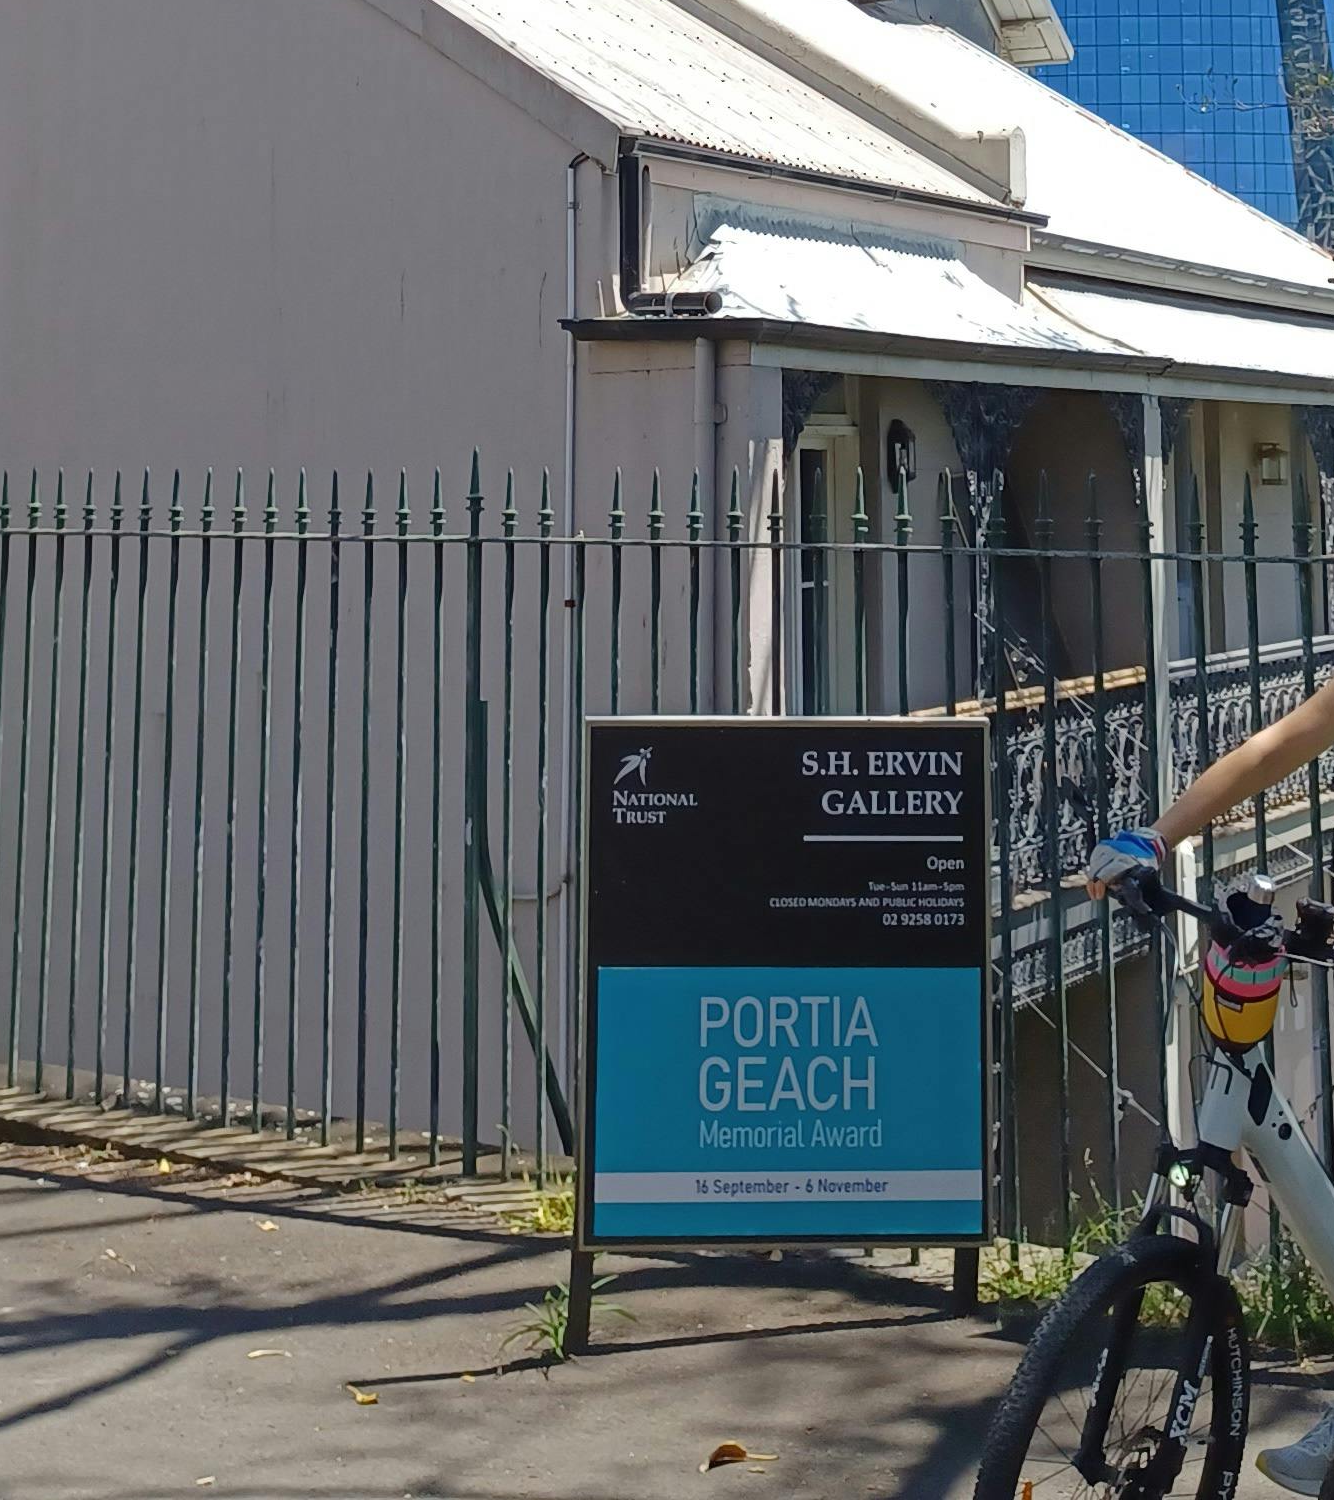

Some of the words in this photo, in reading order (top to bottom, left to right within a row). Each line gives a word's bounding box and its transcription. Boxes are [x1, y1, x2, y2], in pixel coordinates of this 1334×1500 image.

[801, 750, 859, 776] S.H.
[867, 751, 963, 776] ERVIN
[821, 789, 963, 815] GALLERY
[926, 855, 965, 873] Open
[769, 897, 807, 908] CLOSED
[808, 897, 857, 908] MONDAYS
[859, 897, 880, 908] AND
[882, 897, 917, 908] PUBLIC
[918, 897, 965, 908] HOLIDAYS
[882, 913, 898, 926] 02
[900, 913, 932, 926] 9258
[933, 913, 965, 926] 0173
[699, 995, 879, 1048] PORTIA
[698, 1055, 876, 1112] GEACH
[699, 1119, 805, 1149] Memorial
[811, 1118, 883, 1149] Award
[695, 1179, 709, 1195] 16
[713, 1179, 790, 1197] September
[805, 1178, 814, 1194] 6
[817, 1178, 889, 1195] November
[1227, 1327, 1244, 1437] HUTCHINSON
